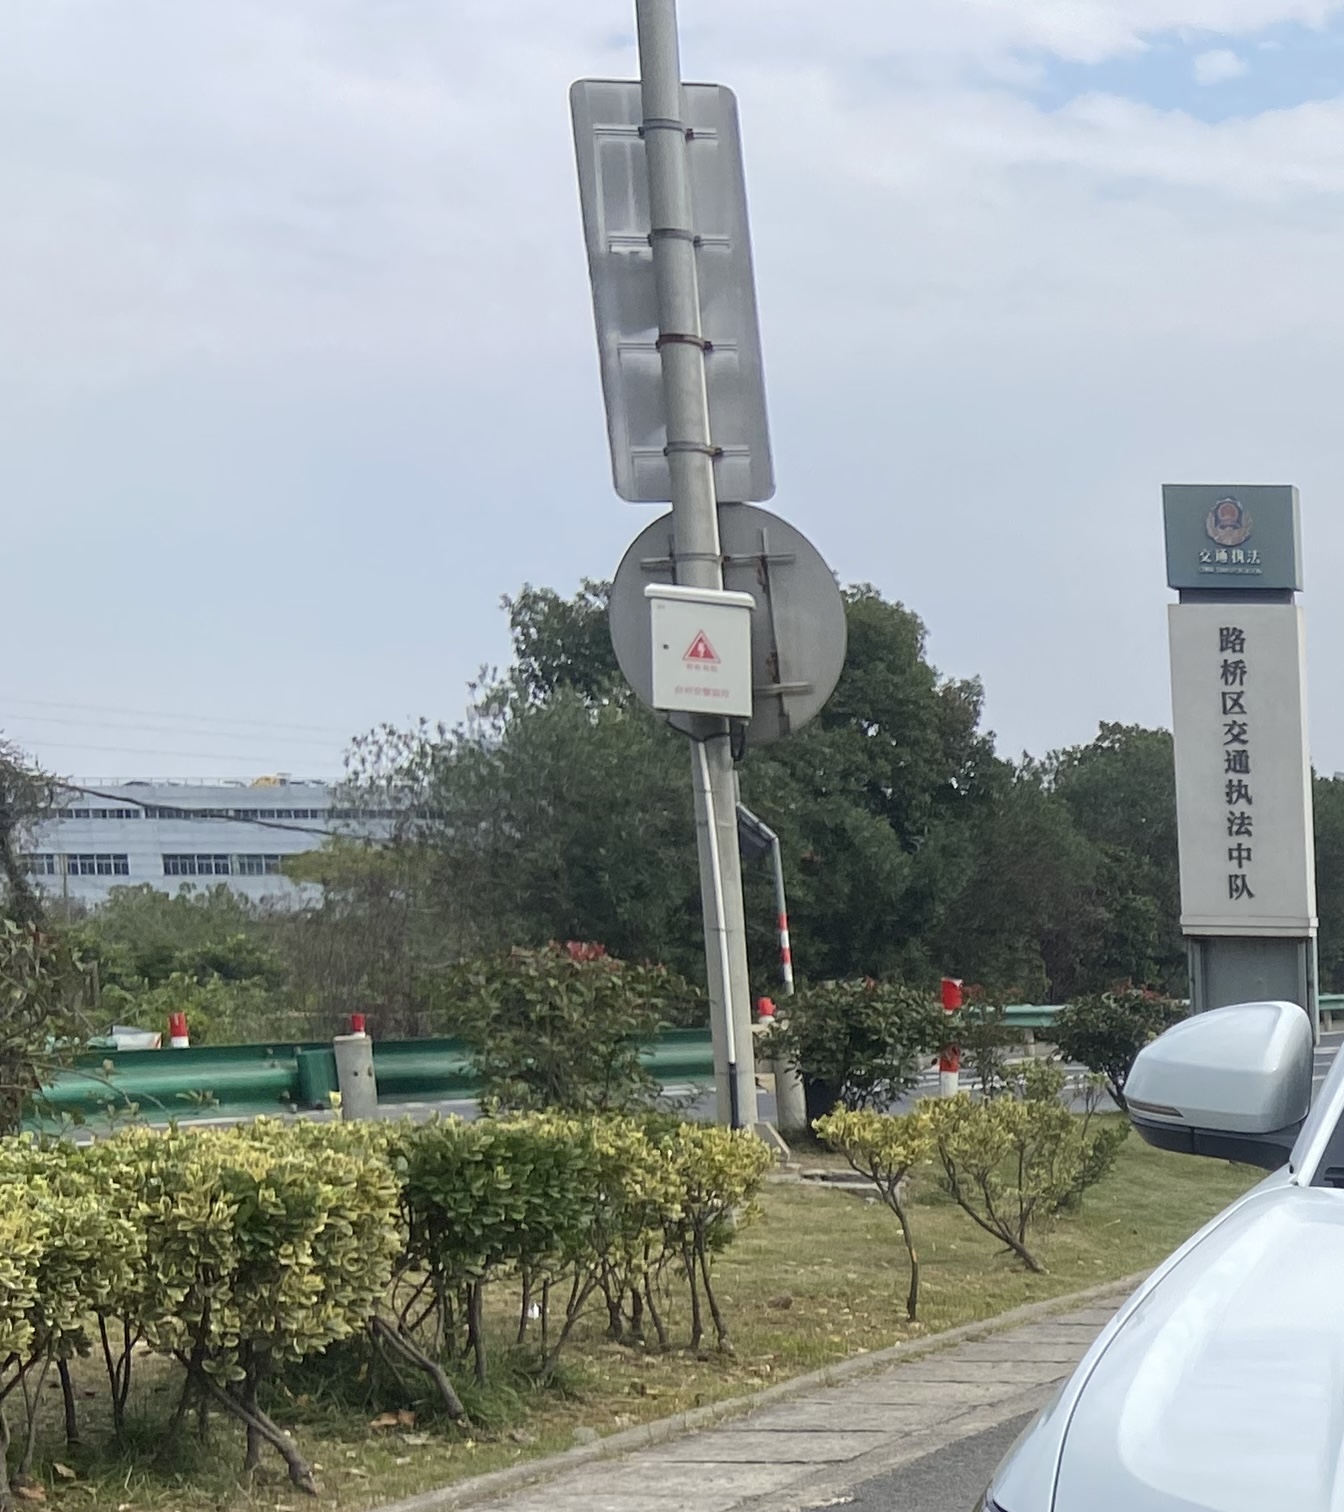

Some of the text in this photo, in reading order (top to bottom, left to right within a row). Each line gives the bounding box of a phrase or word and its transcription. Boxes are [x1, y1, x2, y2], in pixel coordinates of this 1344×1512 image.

[1219, 626, 1254, 900] 路桥区交通执法中队
